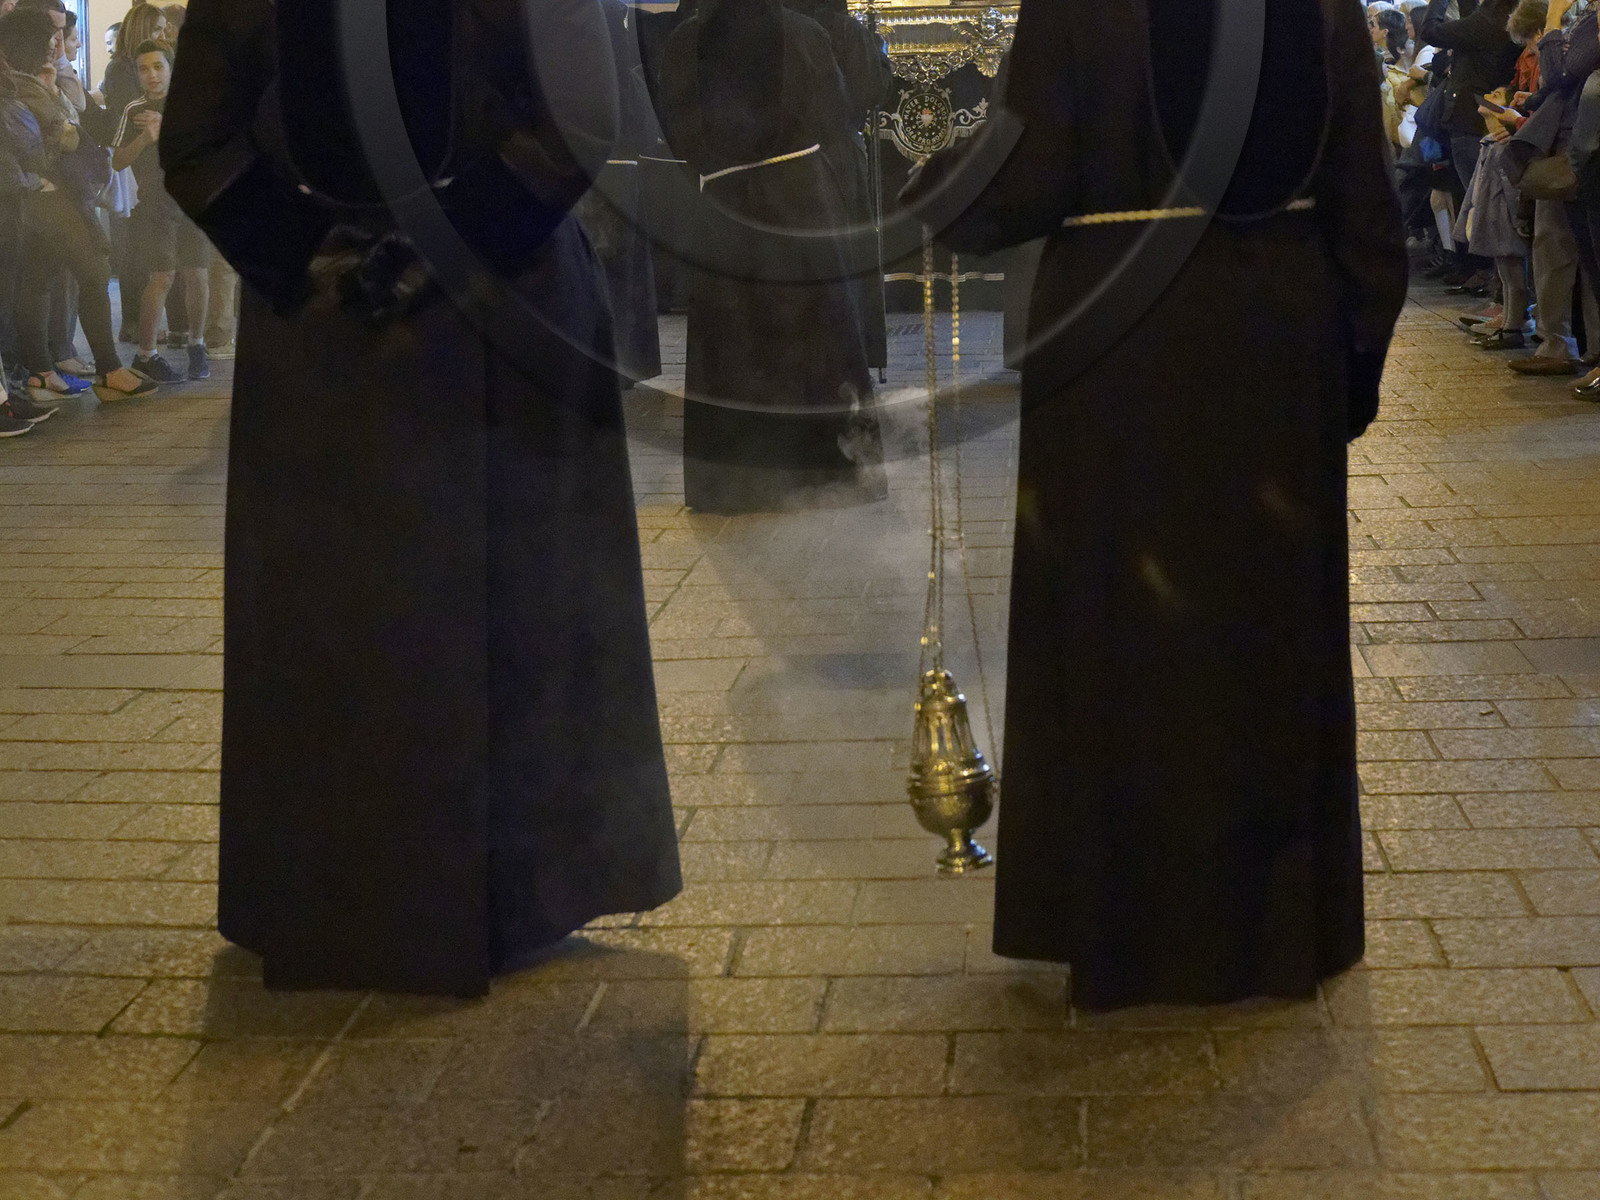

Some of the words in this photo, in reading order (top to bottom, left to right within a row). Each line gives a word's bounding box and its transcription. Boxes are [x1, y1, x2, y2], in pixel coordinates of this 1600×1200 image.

[904, 98, 919, 120] MATER
[905, 126, 917, 140] ORA
[917, 136, 931, 144] PRO
